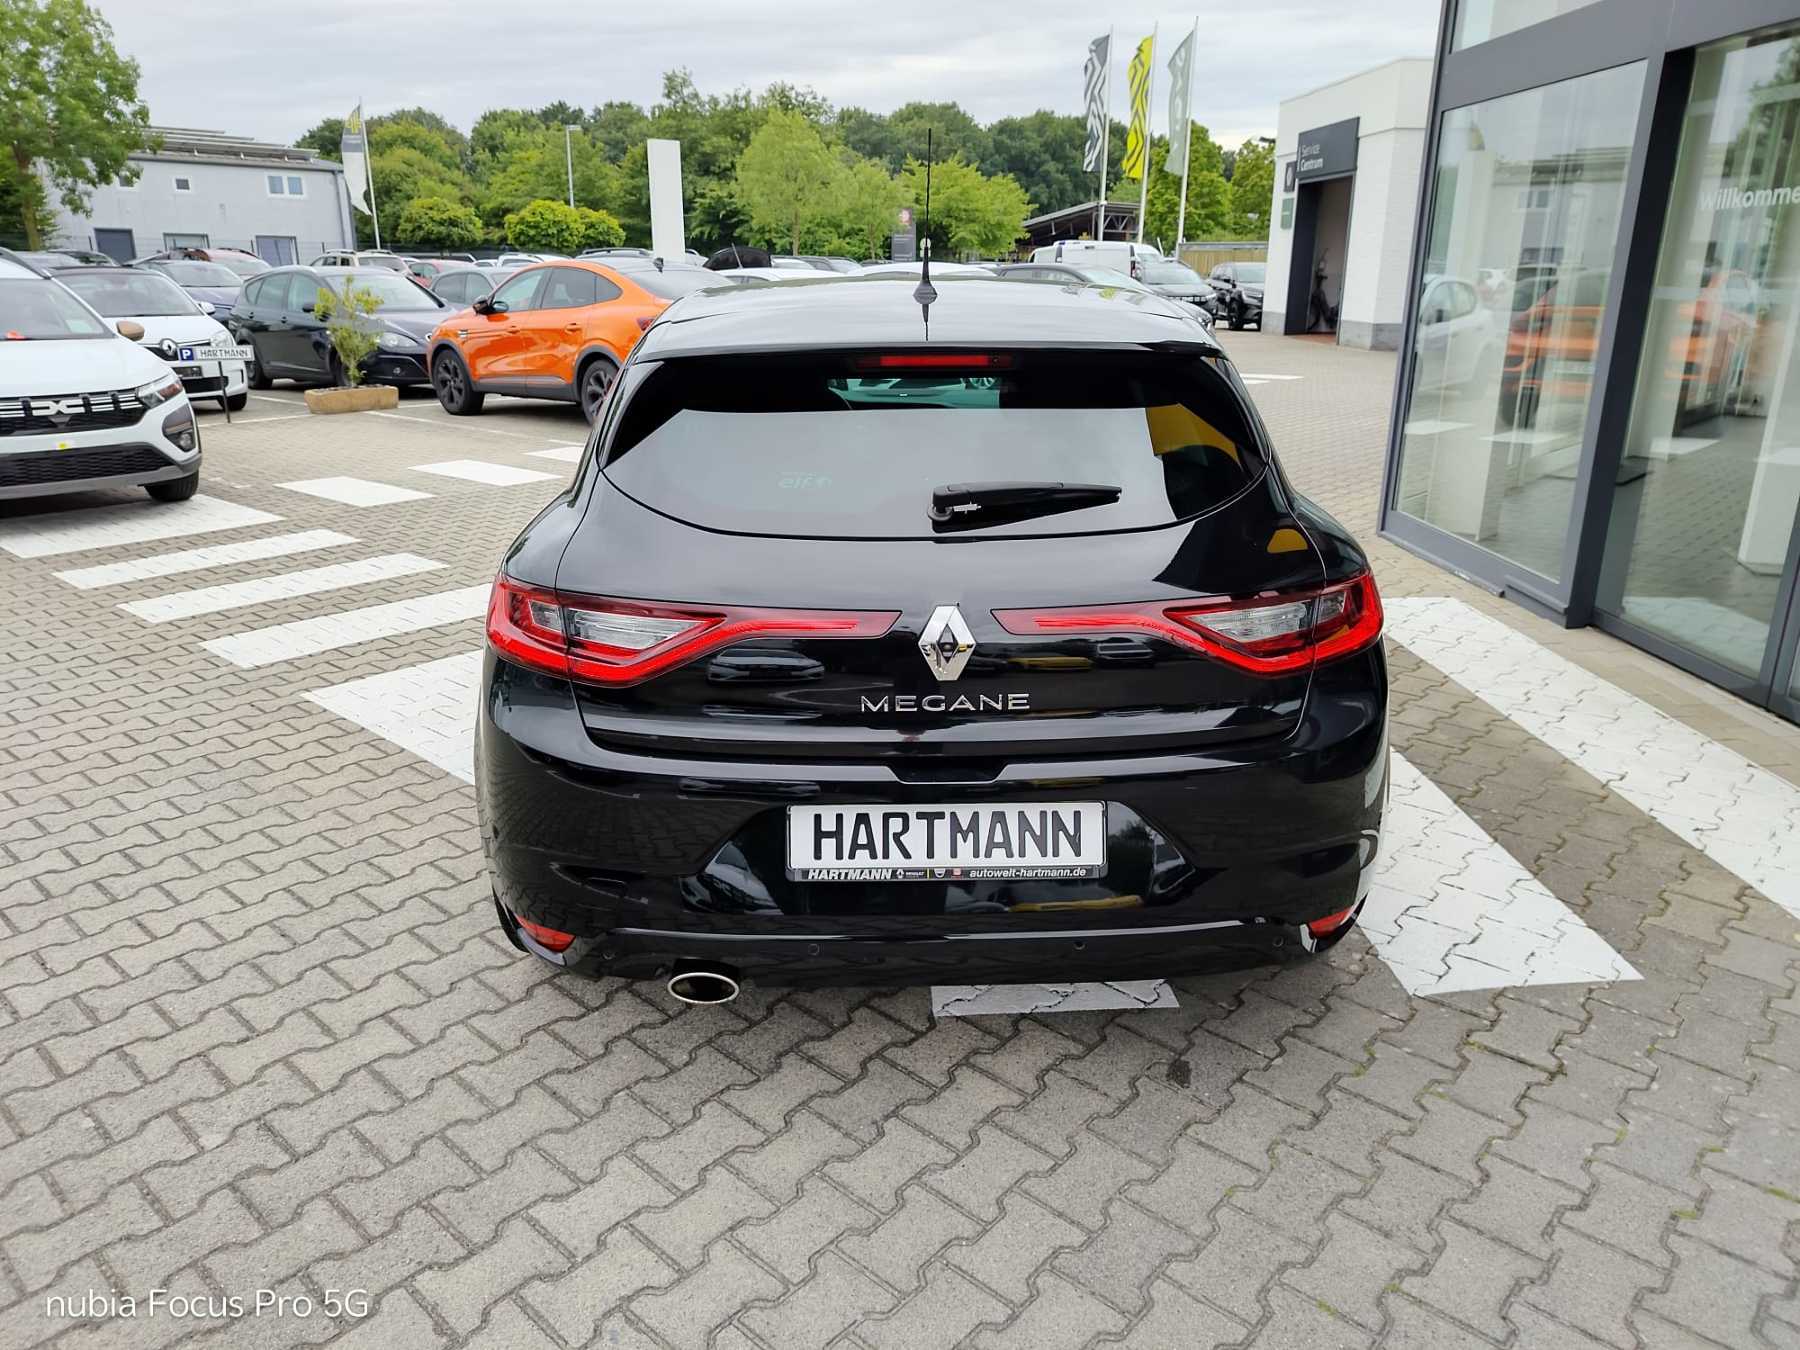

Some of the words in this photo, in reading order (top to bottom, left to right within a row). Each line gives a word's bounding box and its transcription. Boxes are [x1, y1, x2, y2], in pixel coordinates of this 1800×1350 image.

[201, 349, 248, 357] HARTMANN
[860, 693, 1031, 712] MEGANE
[813, 810, 1082, 861] HARTMANN
[807, 868, 892, 880] HARTMANN
[969, 867, 1087, 878] autowelt-hartmann.de
